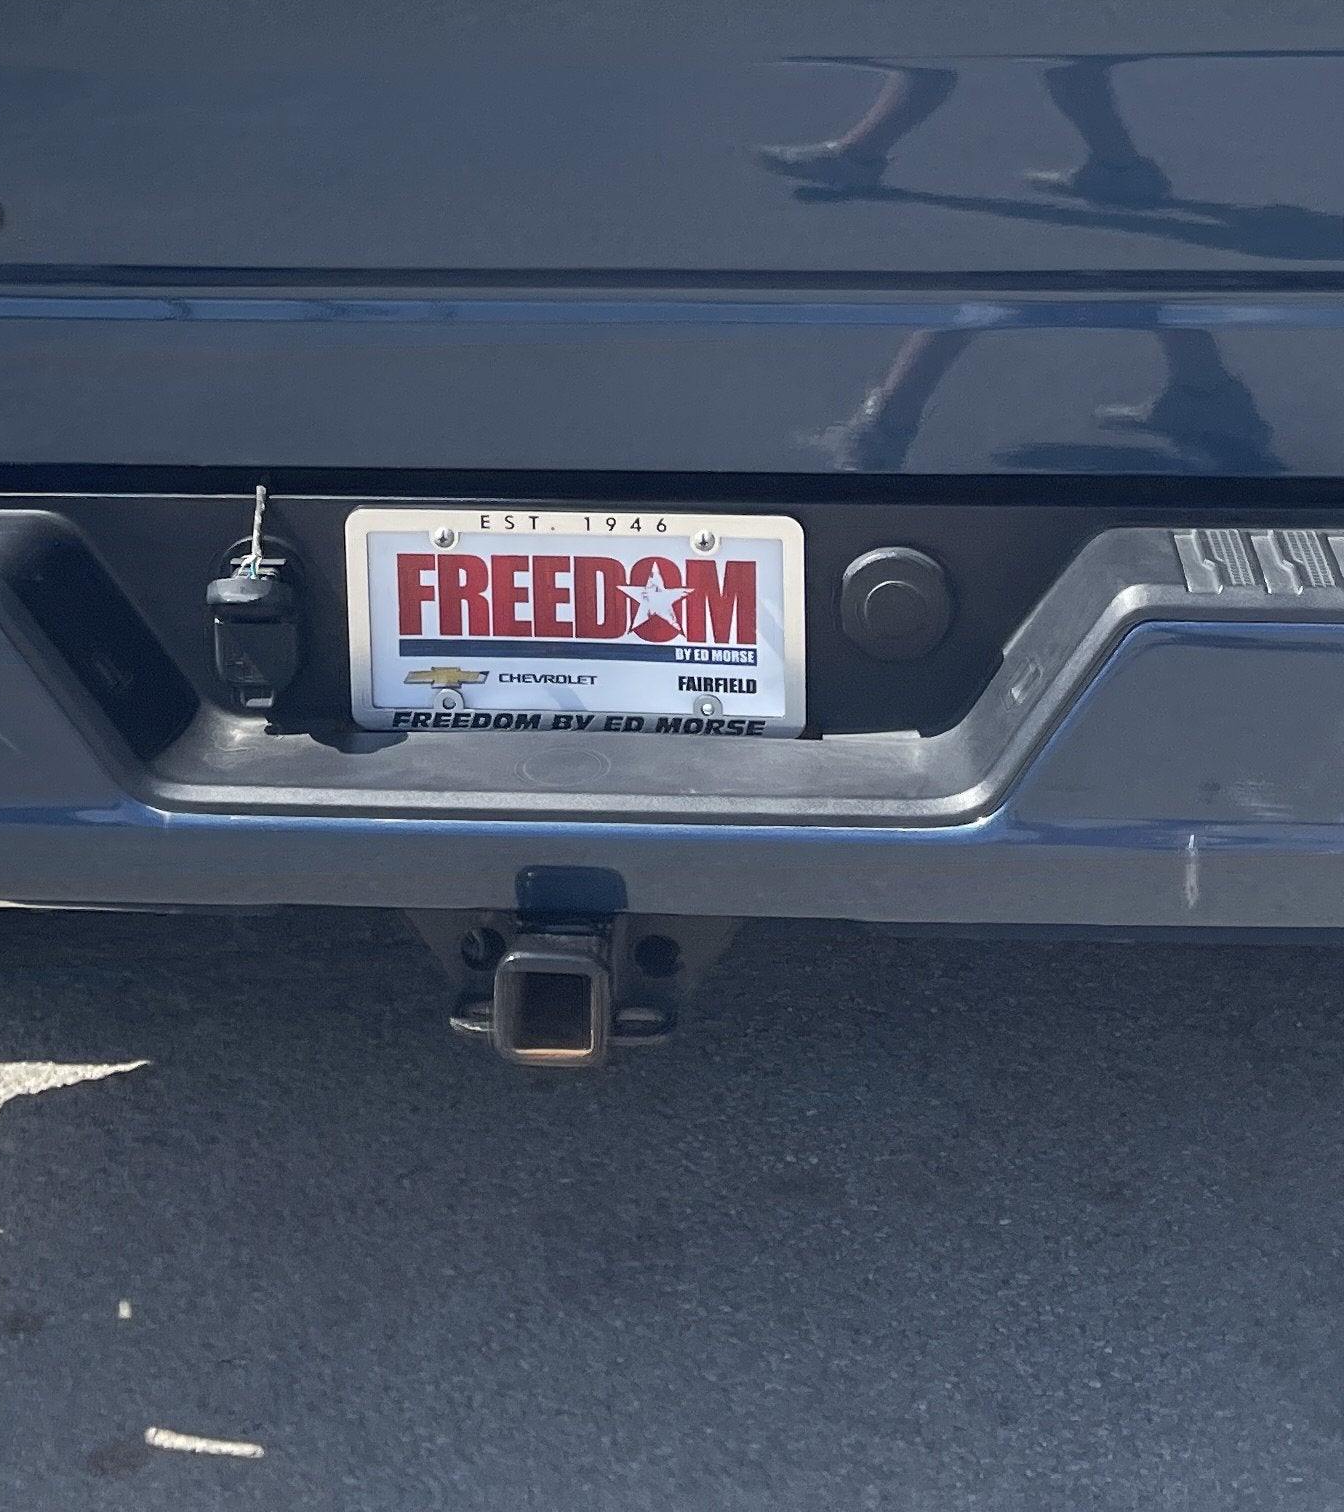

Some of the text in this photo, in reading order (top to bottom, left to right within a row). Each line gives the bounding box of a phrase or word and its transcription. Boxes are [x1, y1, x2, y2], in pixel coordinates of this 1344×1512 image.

[481, 515, 668, 532] EST. 1946
[397, 553, 757, 645] FREEDOM
[675, 648, 755, 664] BY ED MORSE
[498, 672, 598, 686] CHEVROLET
[678, 675, 757, 694] FAIRFIELD
[391, 710, 767, 737] FREEDOM BY ED MORSE
